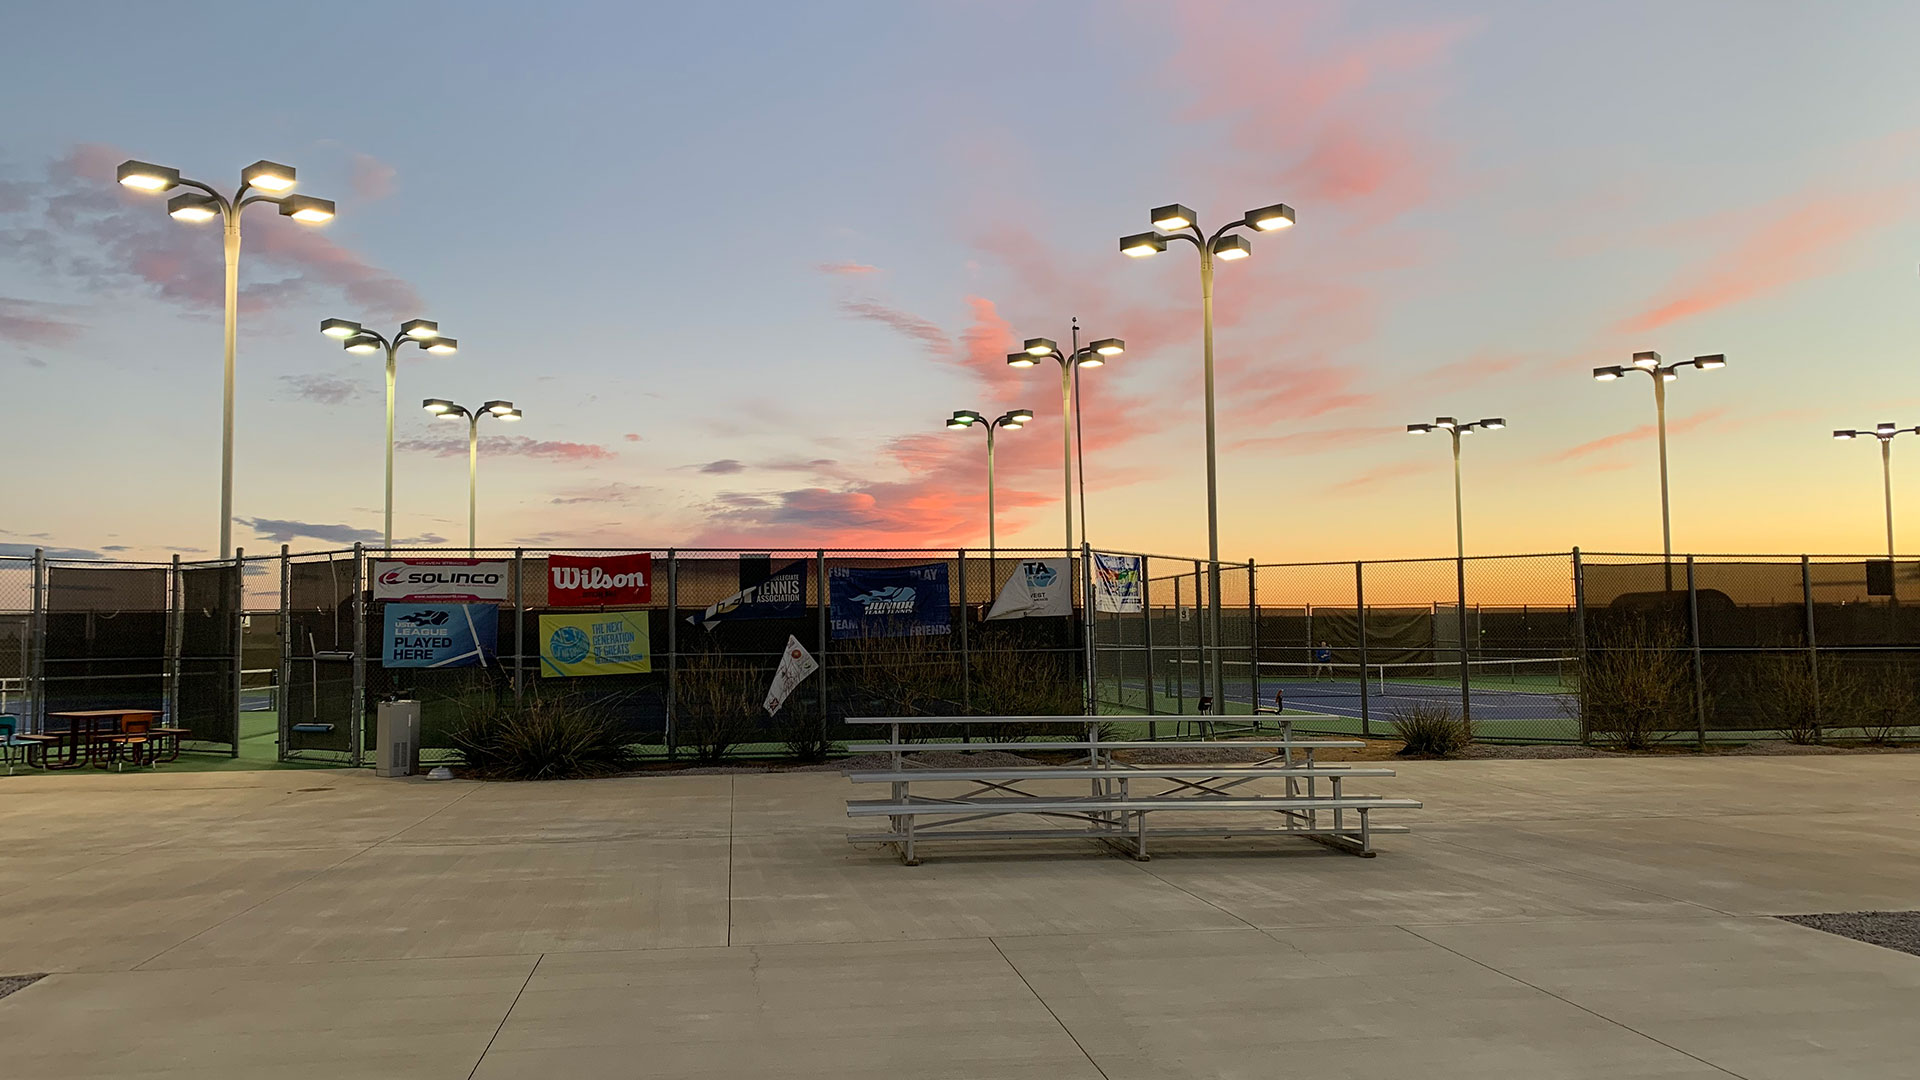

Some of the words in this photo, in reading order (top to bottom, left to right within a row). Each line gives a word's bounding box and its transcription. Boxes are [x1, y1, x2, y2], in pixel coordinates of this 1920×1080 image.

[828, 567, 850, 578] FUN
[1023, 562, 1051, 574] TA
[407, 573, 499, 584] SOLINCO
[551, 566, 645, 590] Wilson
[909, 568, 938, 581] PLAY
[756, 593, 800, 603] ASSOCIATION
[865, 601, 914, 610] JUNIOR
[592, 623, 605, 635] THE
[606, 621, 624, 633] NEXT
[829, 618, 858, 630] TEAM
[394, 628, 448, 636] LEAGUE
[909, 623, 952, 637] FRIENDS
[394, 637, 453, 648] PLAYED
[592, 631, 635, 646] GENERATION
[393, 649, 434, 660] HERE
